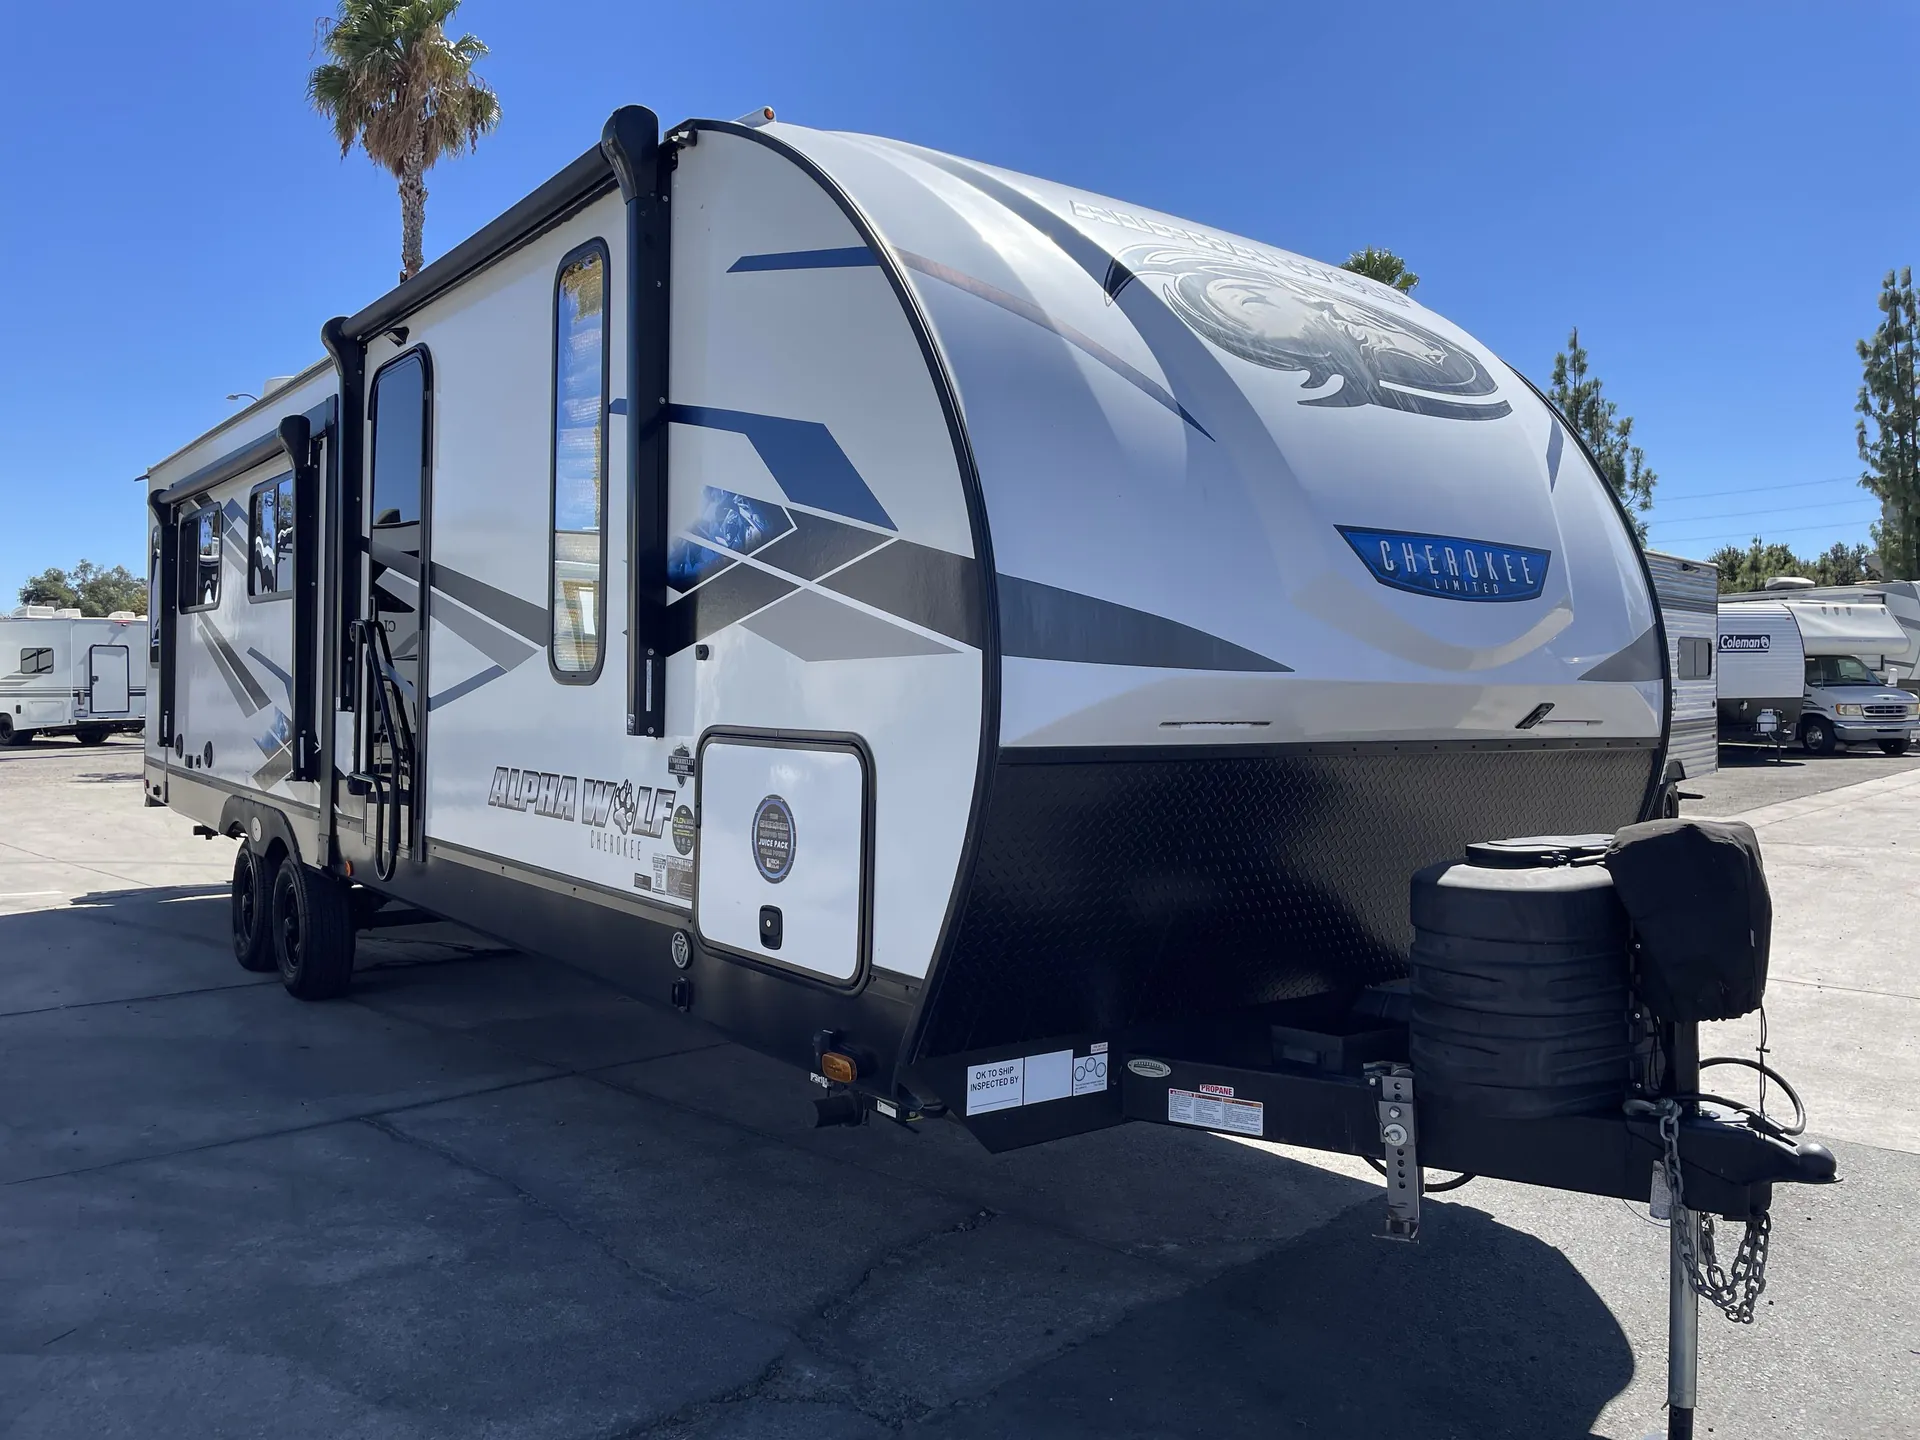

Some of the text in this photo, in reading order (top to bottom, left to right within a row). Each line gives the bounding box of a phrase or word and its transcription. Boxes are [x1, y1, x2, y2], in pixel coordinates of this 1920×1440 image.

[1379, 540, 1534, 584] CHEROKEE
[1433, 578, 1500, 594] LIMITED
[1720, 635, 1760, 649] Coleman
[488, 766, 578, 822] ALPHA
[590, 829, 642, 861] CHEROKEE
[758, 838, 789, 850] JUICE PACK
[975, 1066, 1015, 1080] OK TO SHIP
[970, 1075, 1019, 1092] INSPECTED BY
[1201, 1084, 1233, 1096] PROPANE
